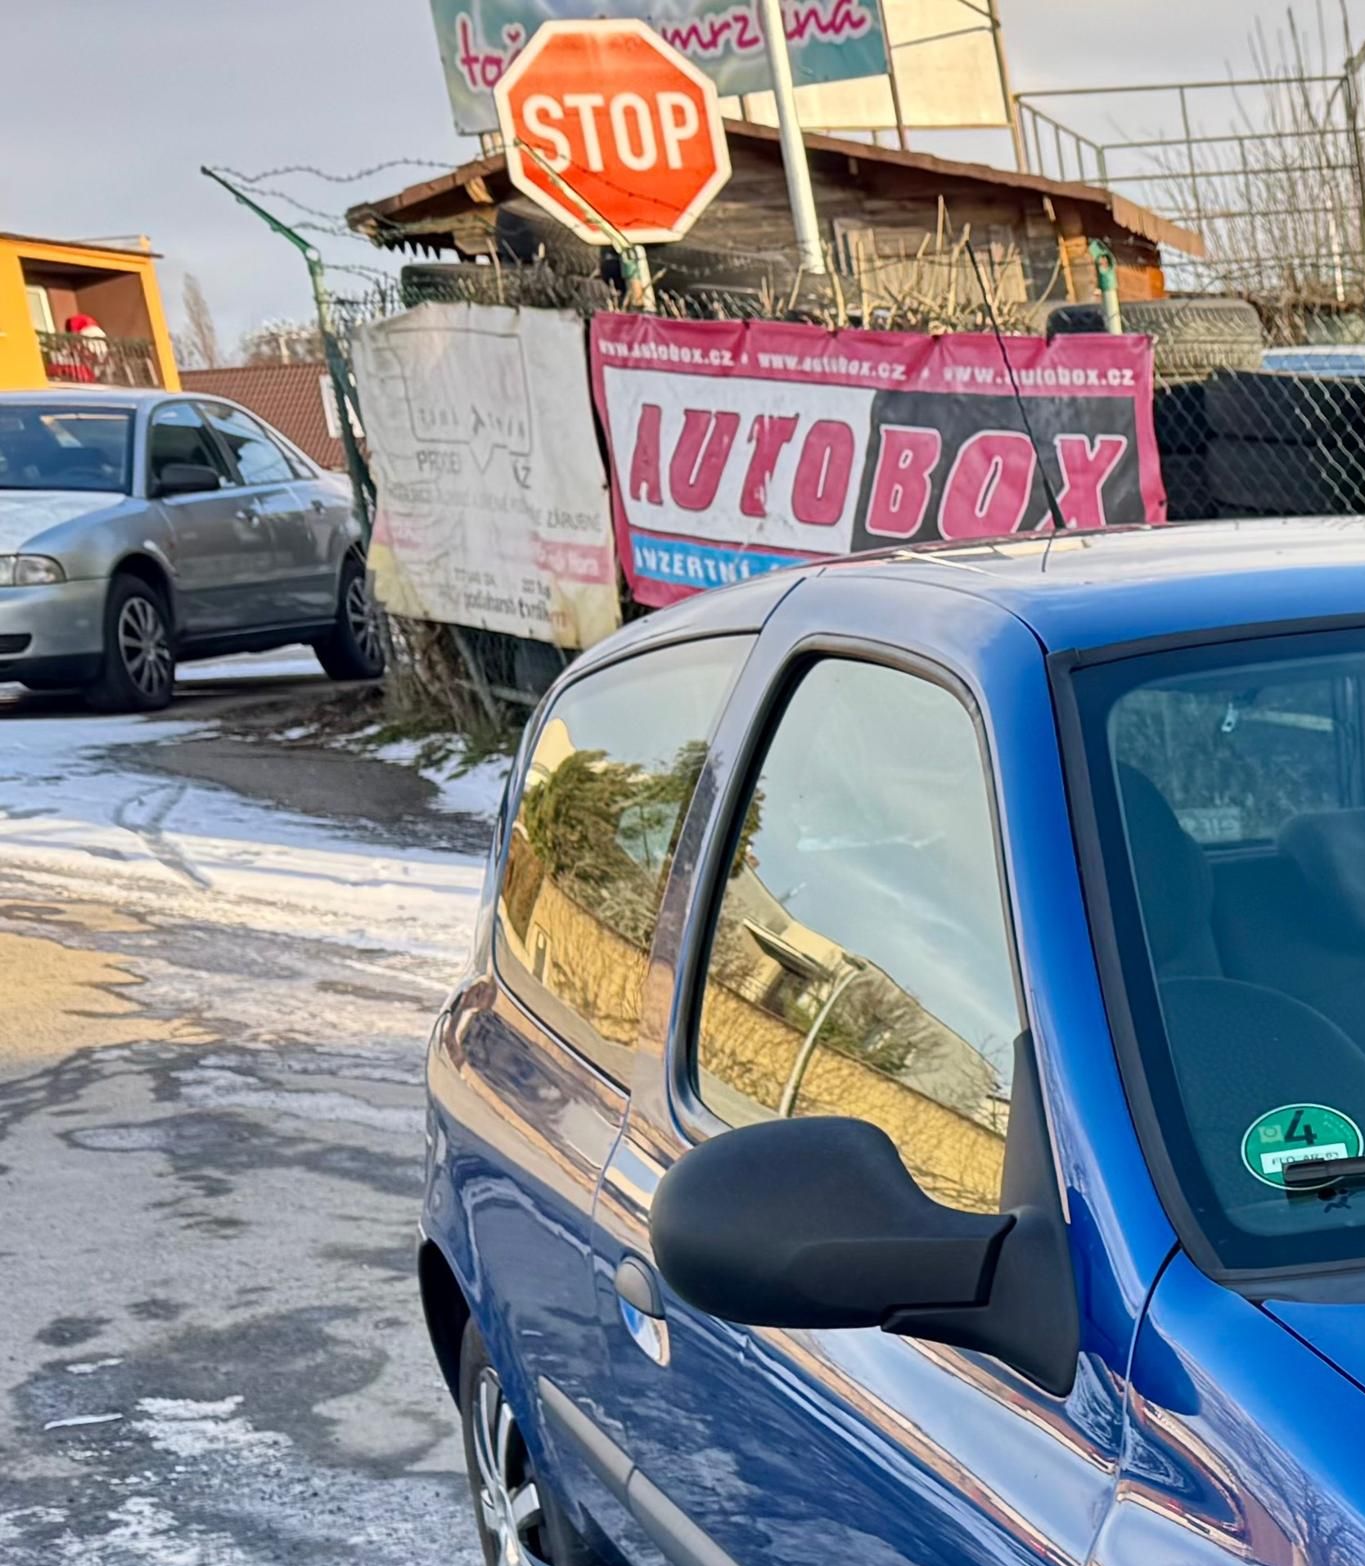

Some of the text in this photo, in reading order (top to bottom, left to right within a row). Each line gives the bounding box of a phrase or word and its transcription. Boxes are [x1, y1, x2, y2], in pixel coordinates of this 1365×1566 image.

[521, 91, 699, 173] STOP
[629, 403, 1127, 541] AUTOBOX
[1284, 1109, 1318, 1145] 4
